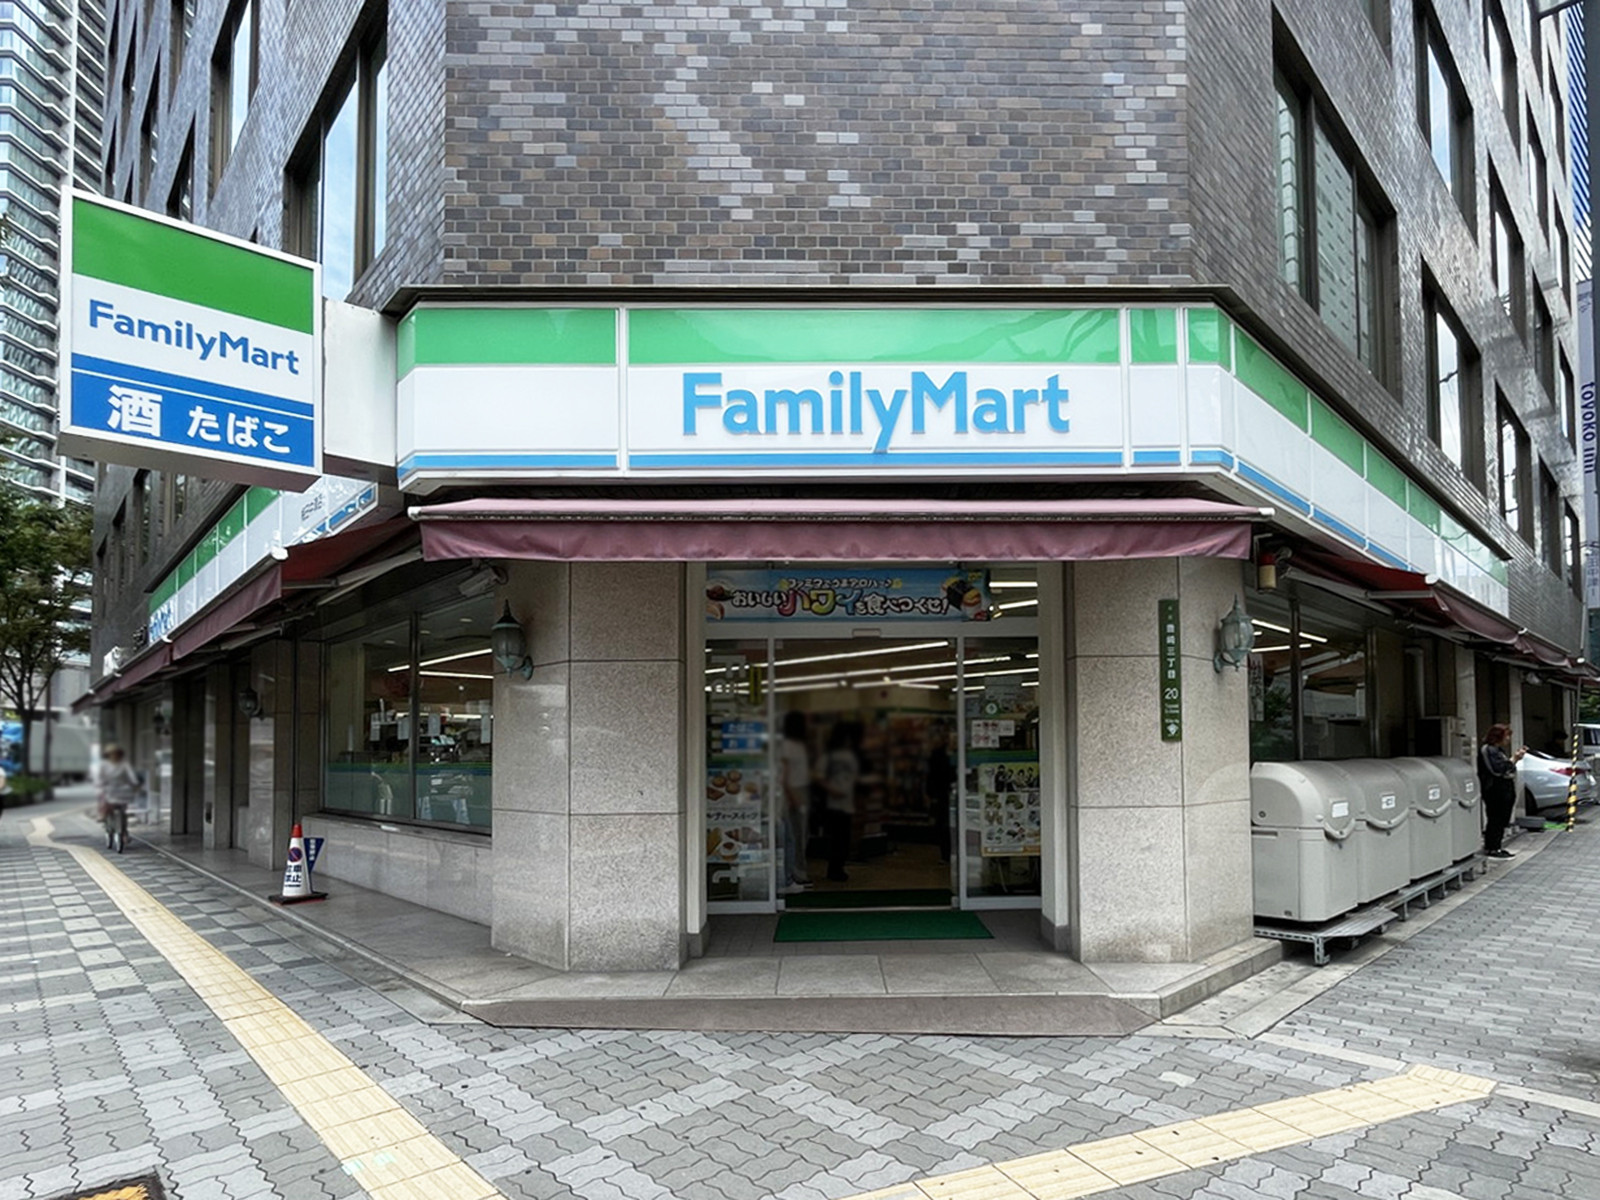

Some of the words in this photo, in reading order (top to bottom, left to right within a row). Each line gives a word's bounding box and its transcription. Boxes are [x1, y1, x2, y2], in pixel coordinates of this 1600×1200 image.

[89, 298, 300, 376] FamilyMart
[107, 384, 163, 438] 酒
[187, 405, 290, 454] たばこ
[682, 370, 1070, 454] FamilyMart
[1164, 687, 1179, 700] 20
